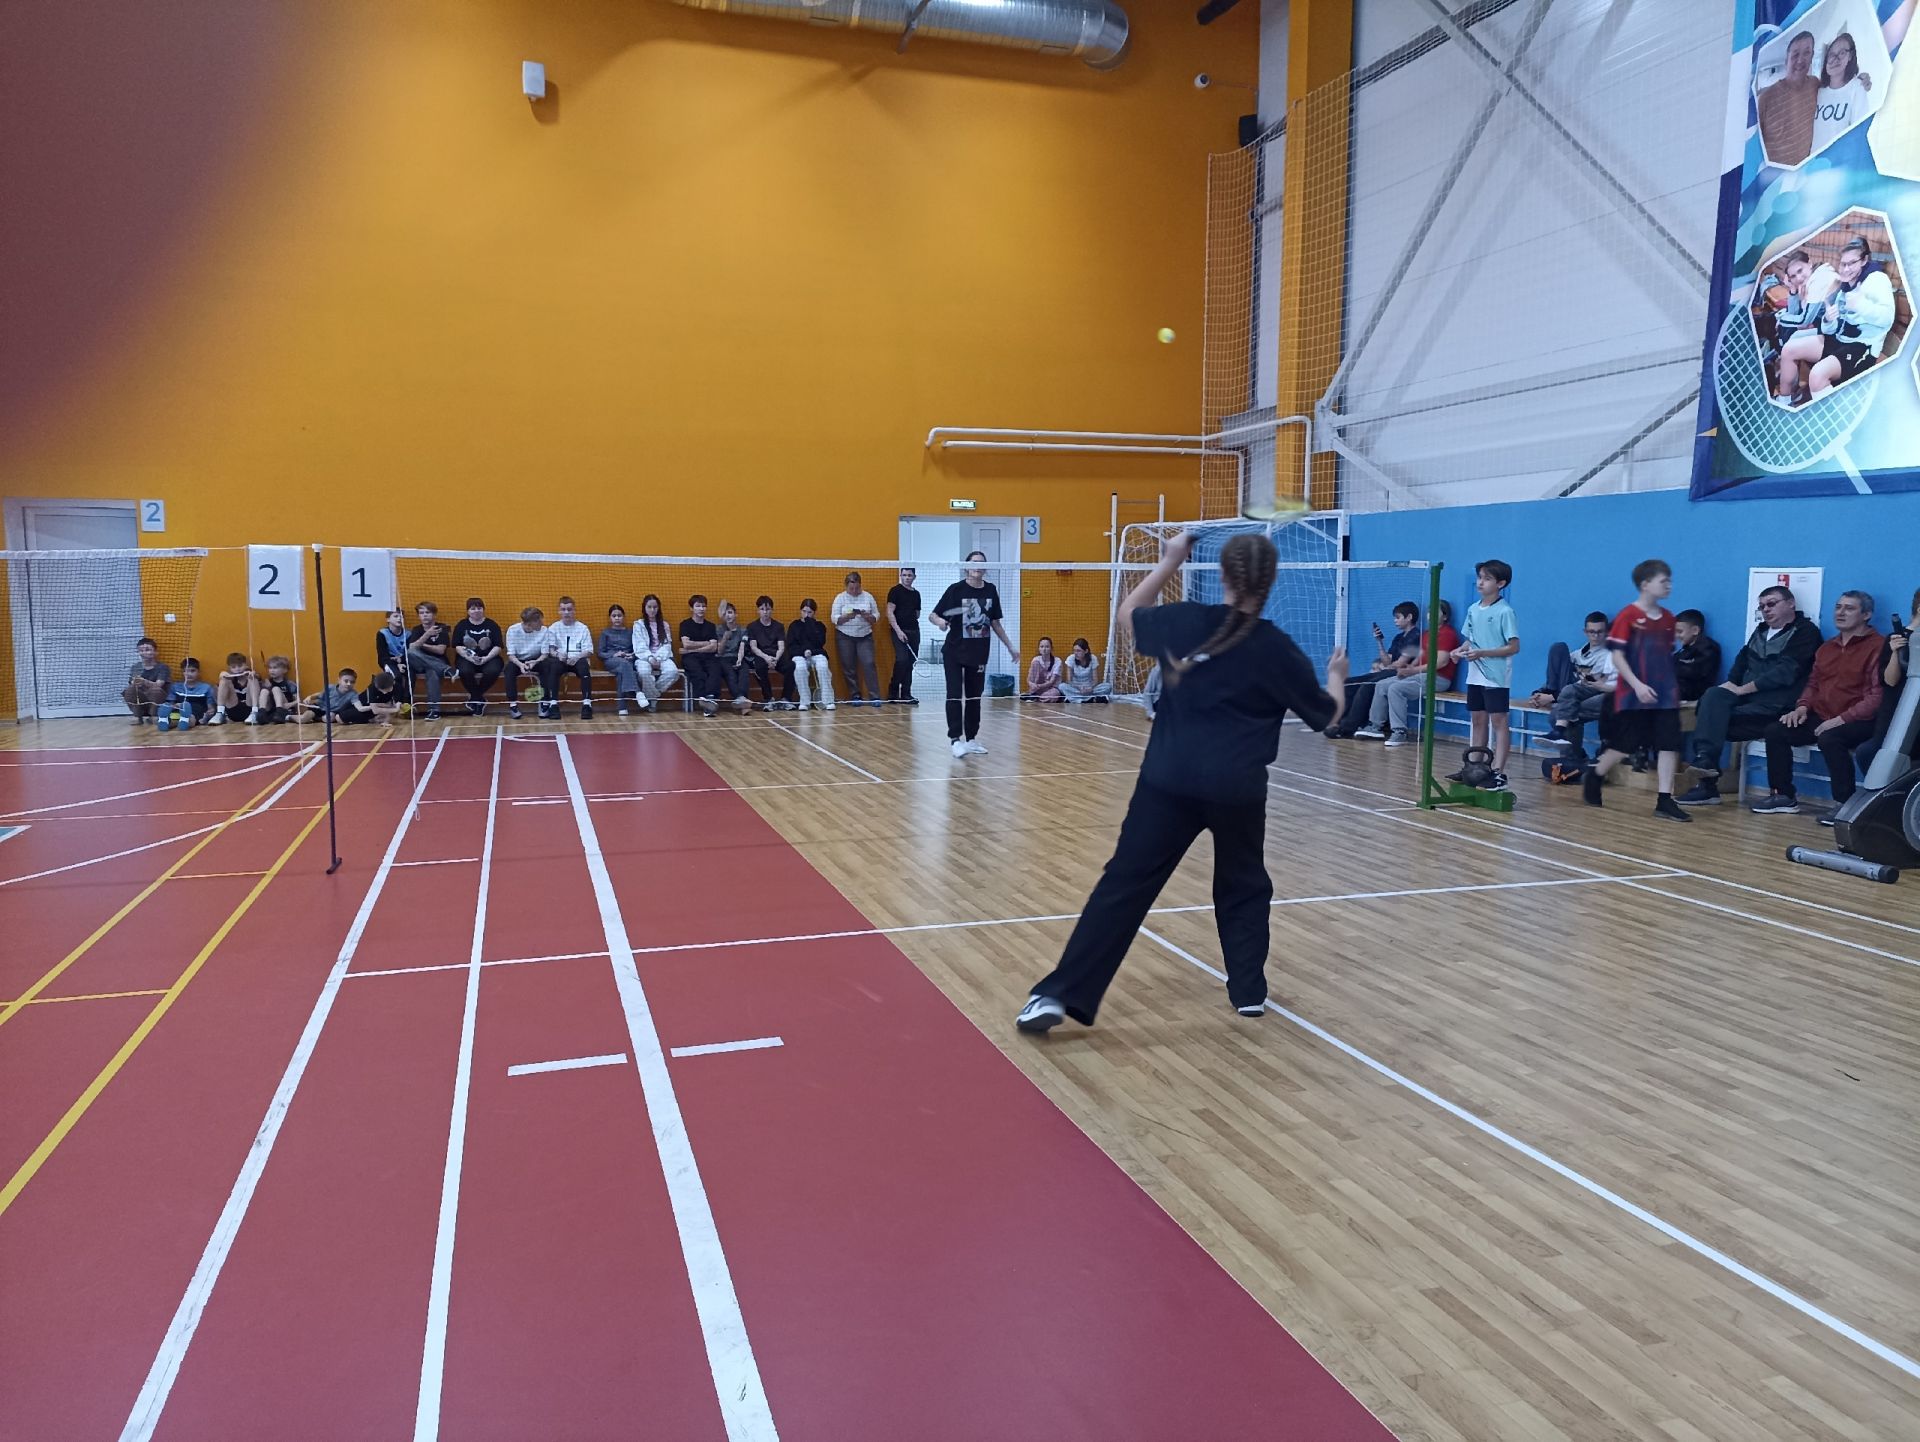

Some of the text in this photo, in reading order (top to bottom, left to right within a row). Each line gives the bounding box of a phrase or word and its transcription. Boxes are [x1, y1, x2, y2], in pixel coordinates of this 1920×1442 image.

[1814, 103, 1848, 121] YOU
[145, 502, 161, 522] 2
[1027, 518, 1037, 535] 3
[258, 563, 280, 595] 2
[352, 567, 372, 598] 1
